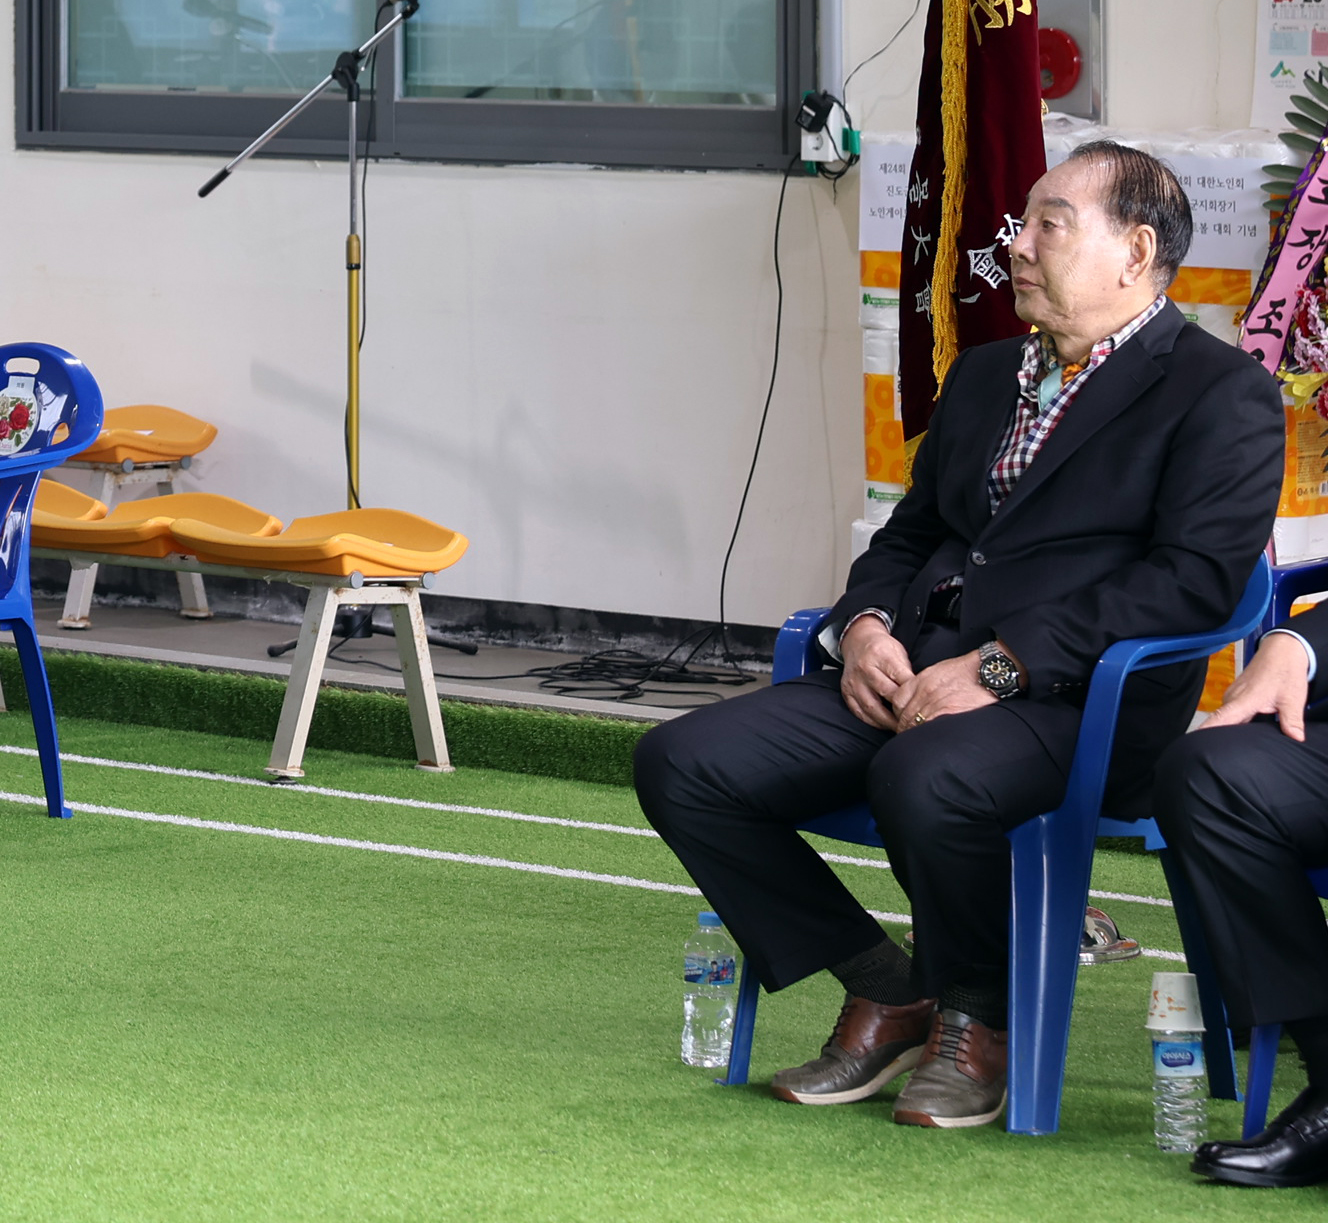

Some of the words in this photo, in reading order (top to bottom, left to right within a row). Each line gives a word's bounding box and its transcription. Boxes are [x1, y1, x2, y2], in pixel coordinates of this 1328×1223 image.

[879, 163, 905, 174] 제24회
[1197, 176, 1244, 190] 대한노인회
[869, 207, 907, 220] 노인게이
[1213, 223, 1231, 235] 대회
[1238, 224, 1257, 237] 기념
